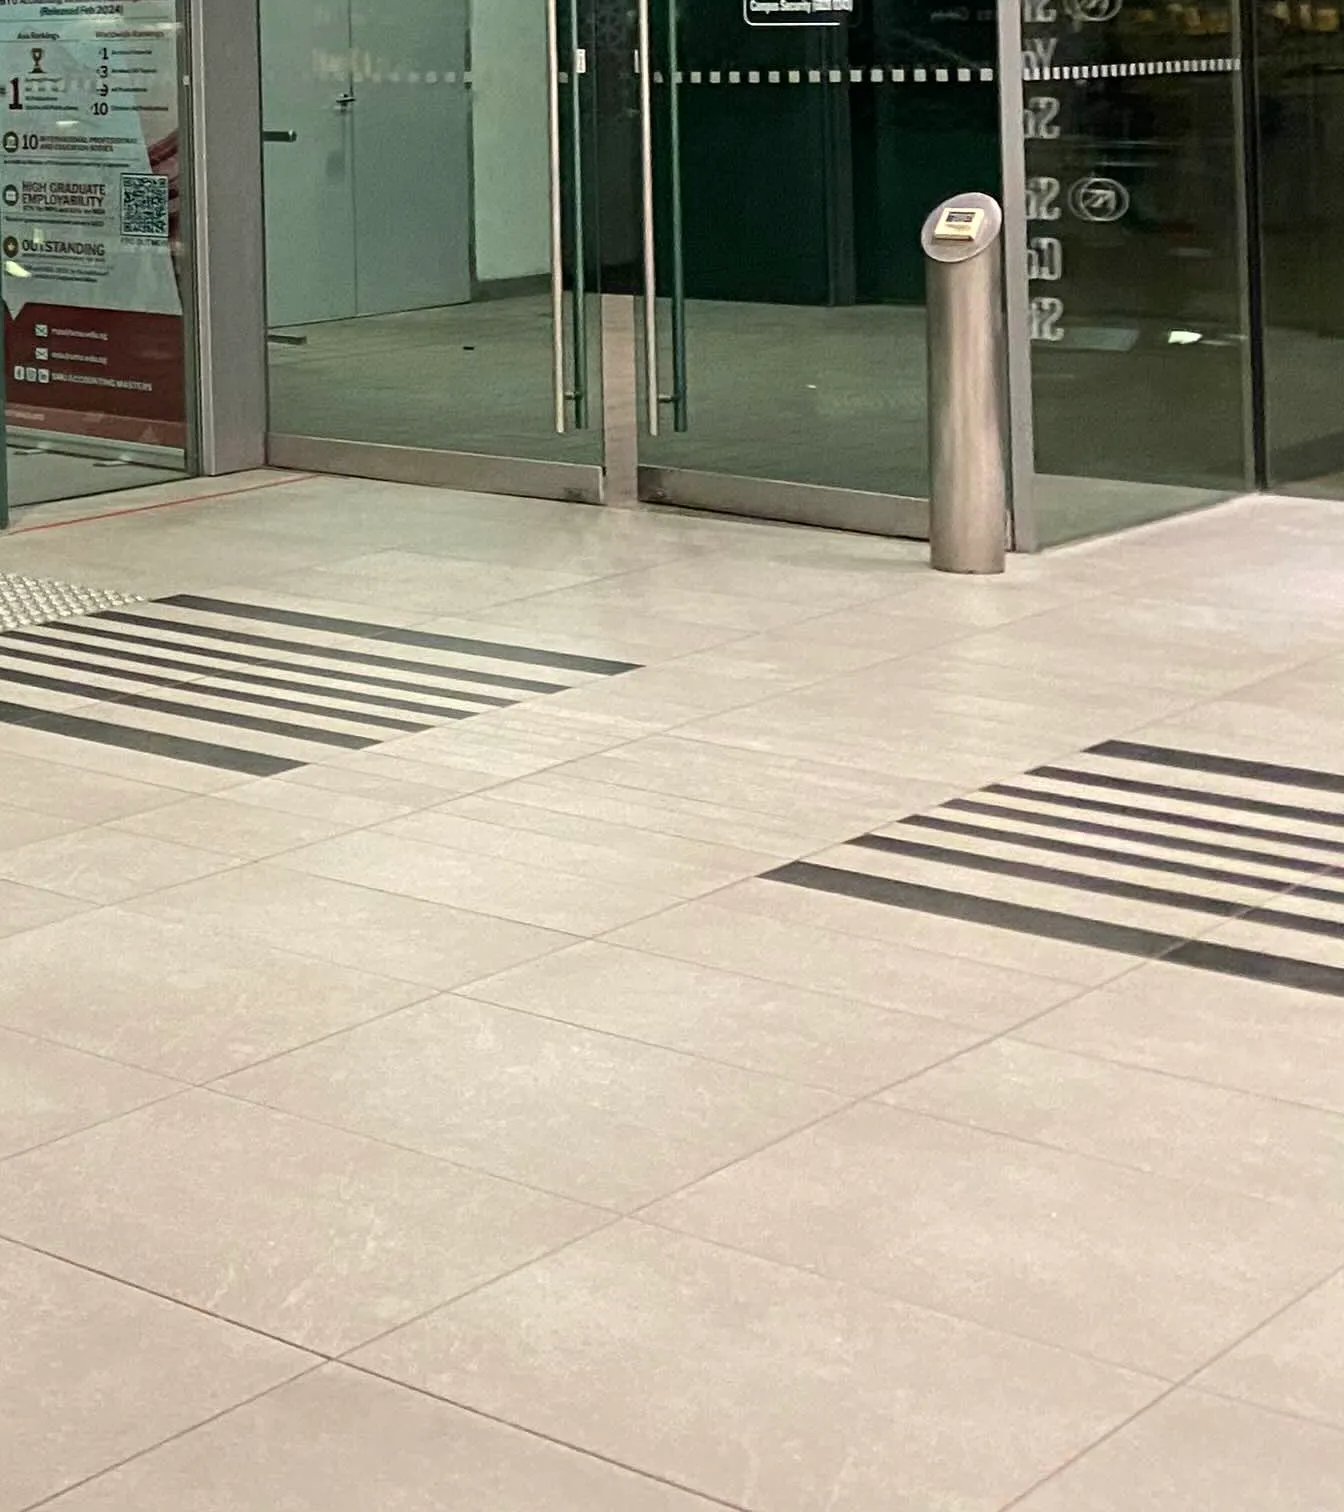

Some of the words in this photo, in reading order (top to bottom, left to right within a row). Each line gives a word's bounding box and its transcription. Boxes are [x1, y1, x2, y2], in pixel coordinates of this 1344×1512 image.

[22, 134, 38, 150] 10
[22, 181, 47, 193] HIGH
[49, 183, 106, 196] GRADUATE
[23, 194, 103, 207] EMPLOYABILITY
